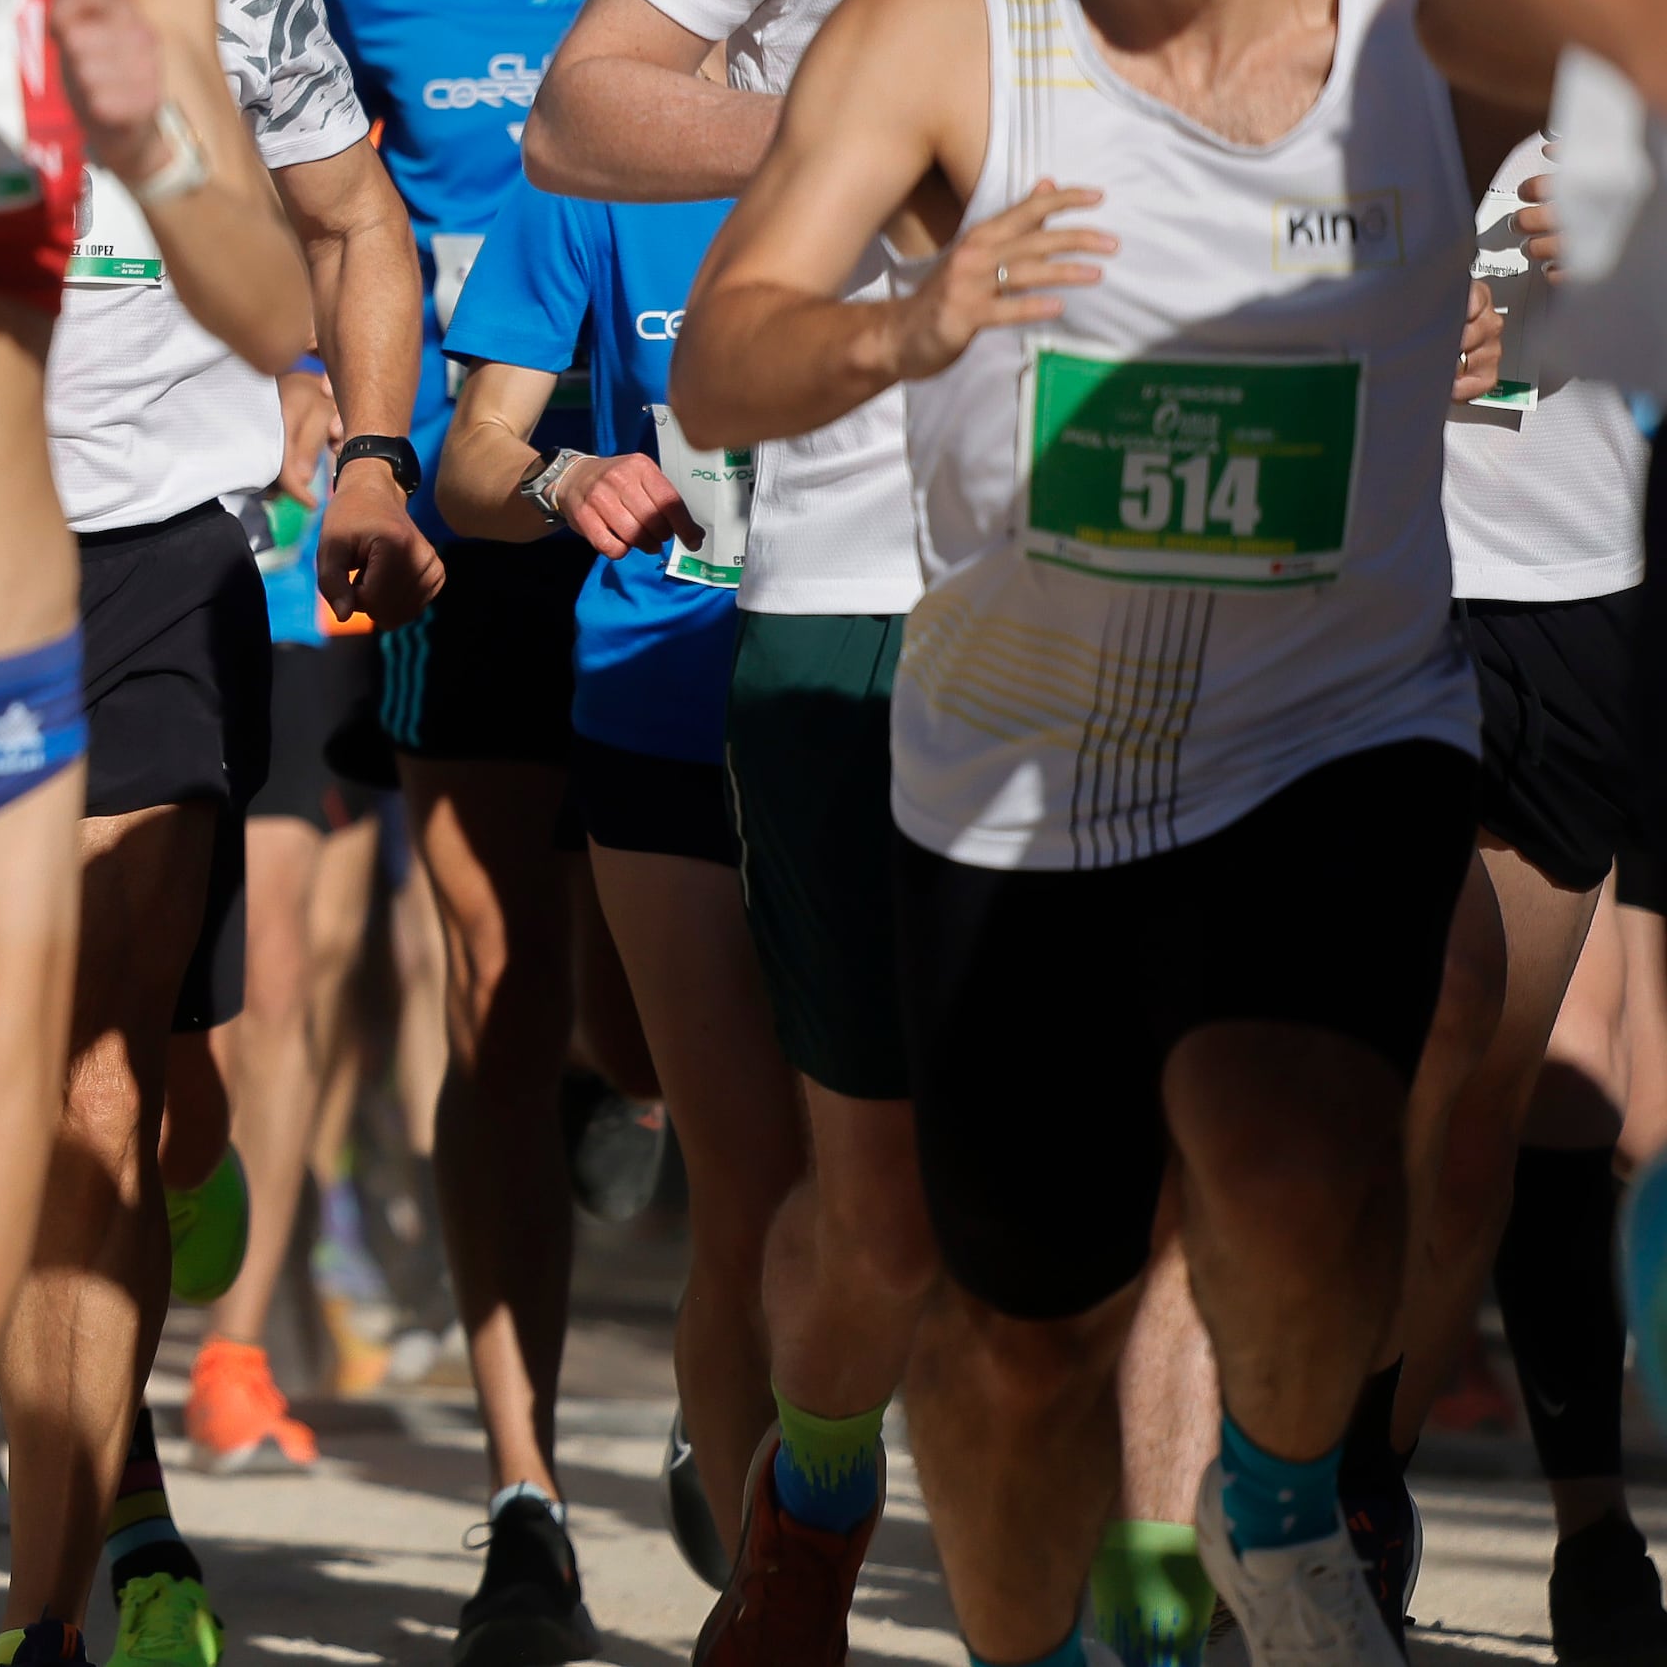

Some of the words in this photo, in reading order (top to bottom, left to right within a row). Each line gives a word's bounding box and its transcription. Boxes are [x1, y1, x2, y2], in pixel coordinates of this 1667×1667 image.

[85, 245, 114, 257] LOPEZ
[691, 468, 755, 482] POLVO
[1118, 451, 1262, 537] 514
